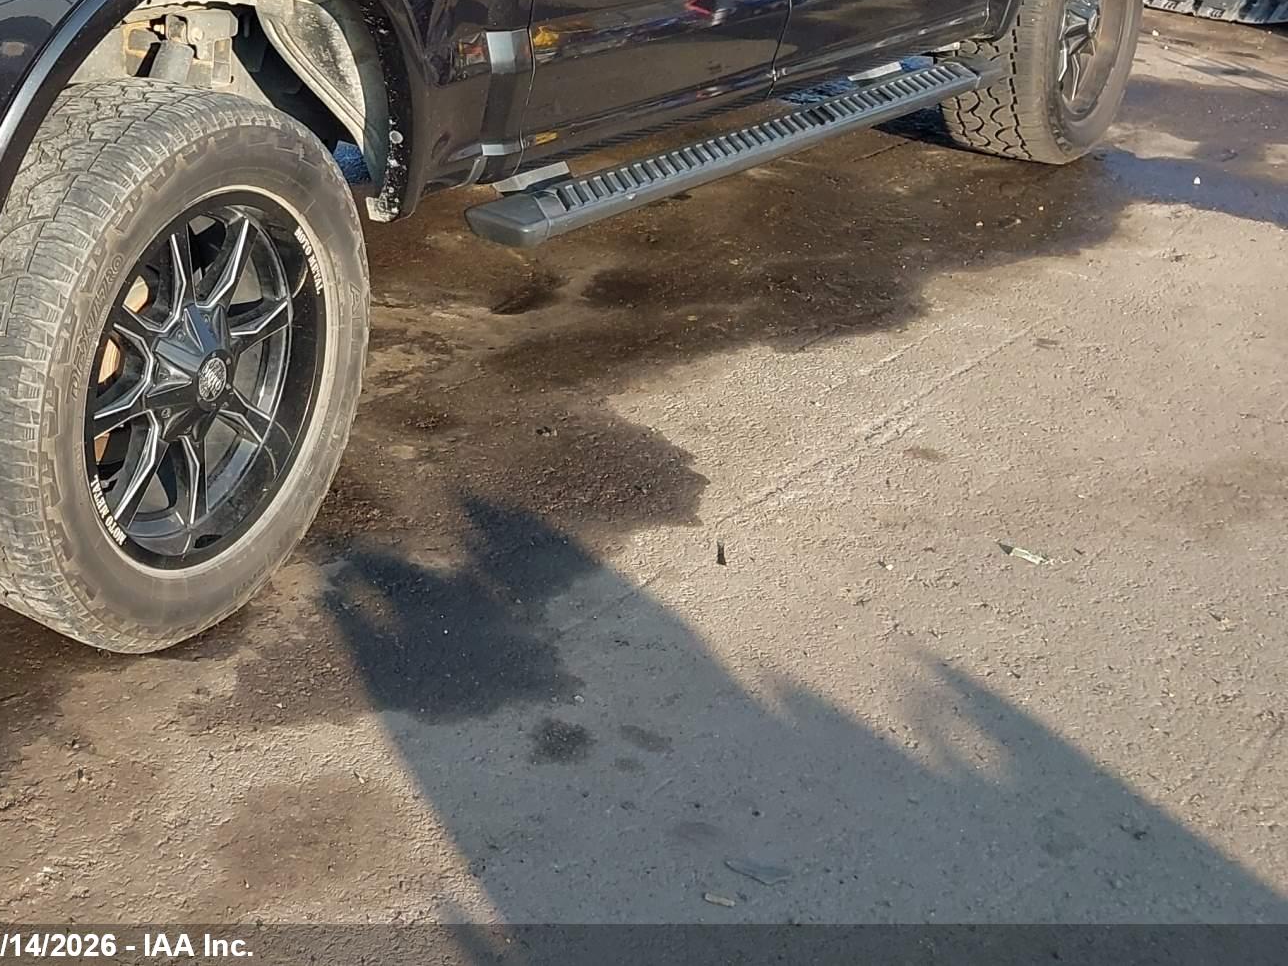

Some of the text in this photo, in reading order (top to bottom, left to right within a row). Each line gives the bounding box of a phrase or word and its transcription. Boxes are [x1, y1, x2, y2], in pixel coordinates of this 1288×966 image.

[294, 225, 324, 296] MOTO METAL
[90, 473, 128, 546] MOTO METAL
